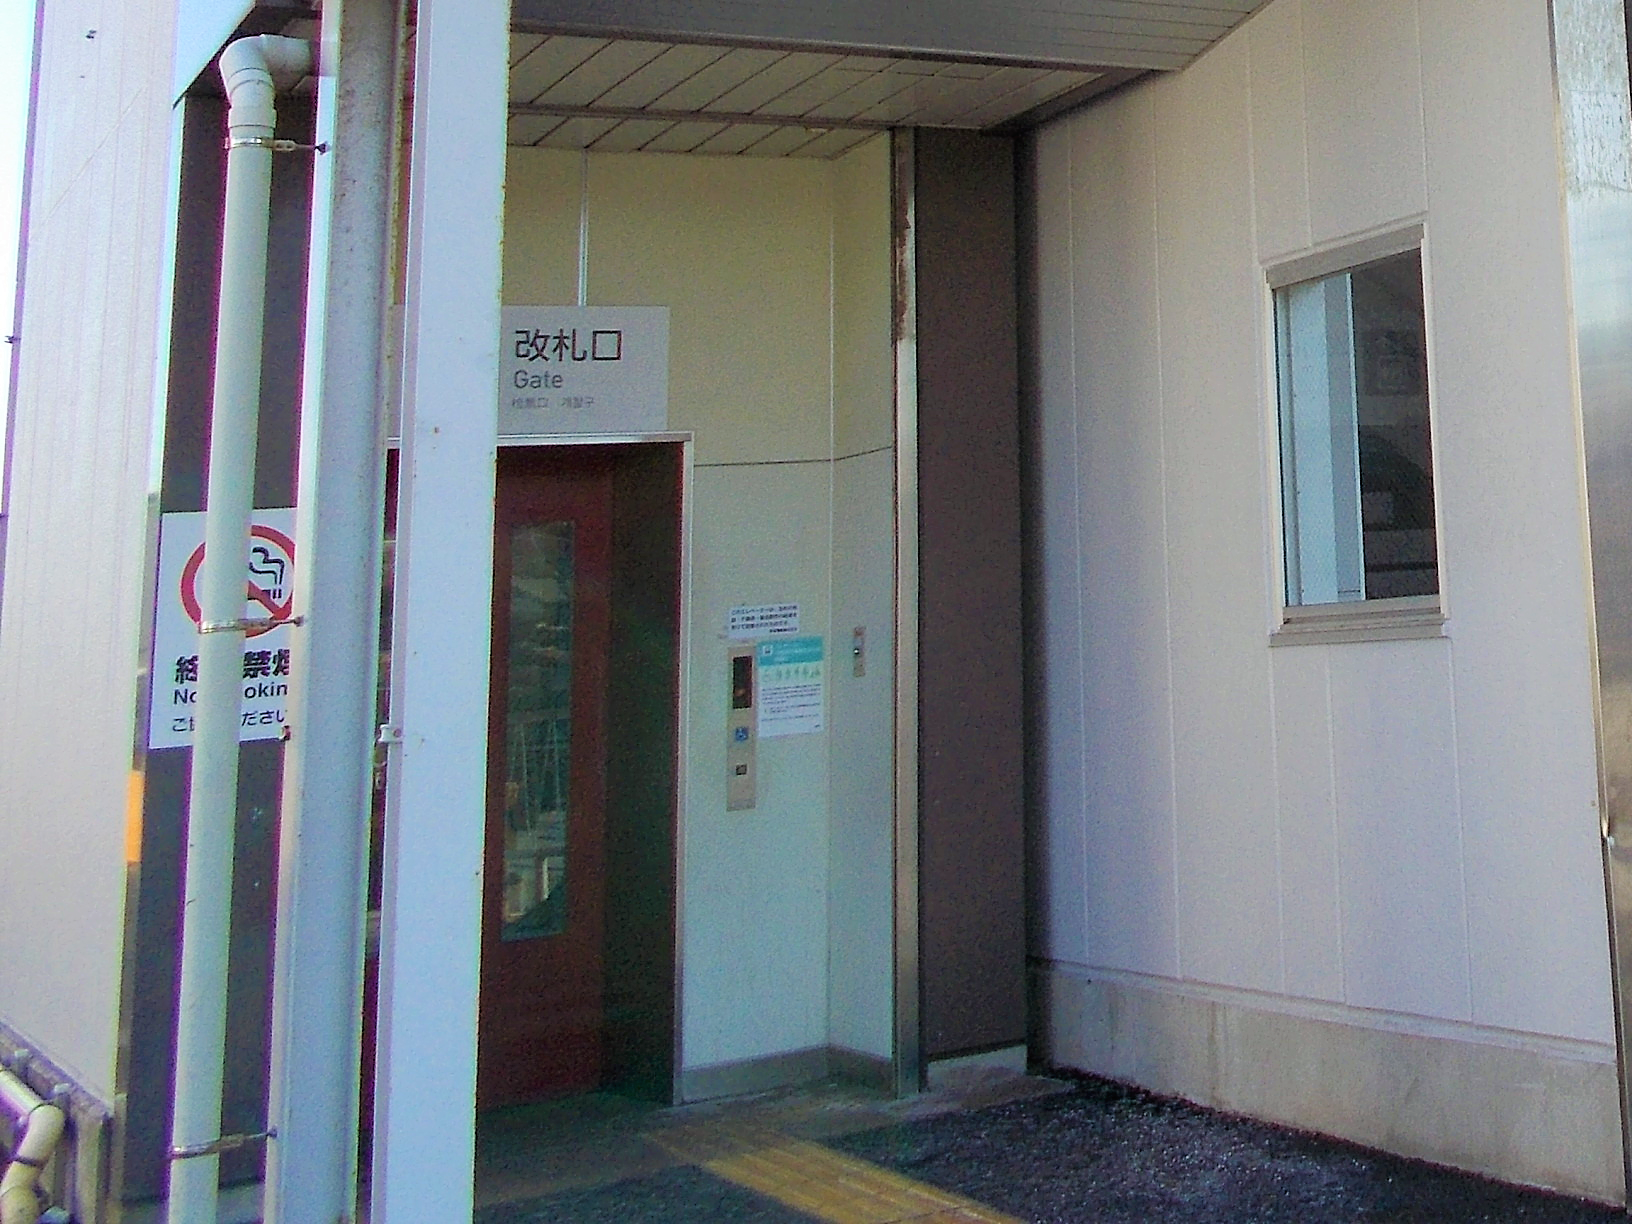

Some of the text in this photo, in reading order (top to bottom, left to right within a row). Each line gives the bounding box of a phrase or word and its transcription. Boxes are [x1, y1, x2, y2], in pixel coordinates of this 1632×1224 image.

[514, 328, 622, 362] 改札口
[514, 369, 563, 388] Gate
[174, 648, 291, 684] 終禁煙
